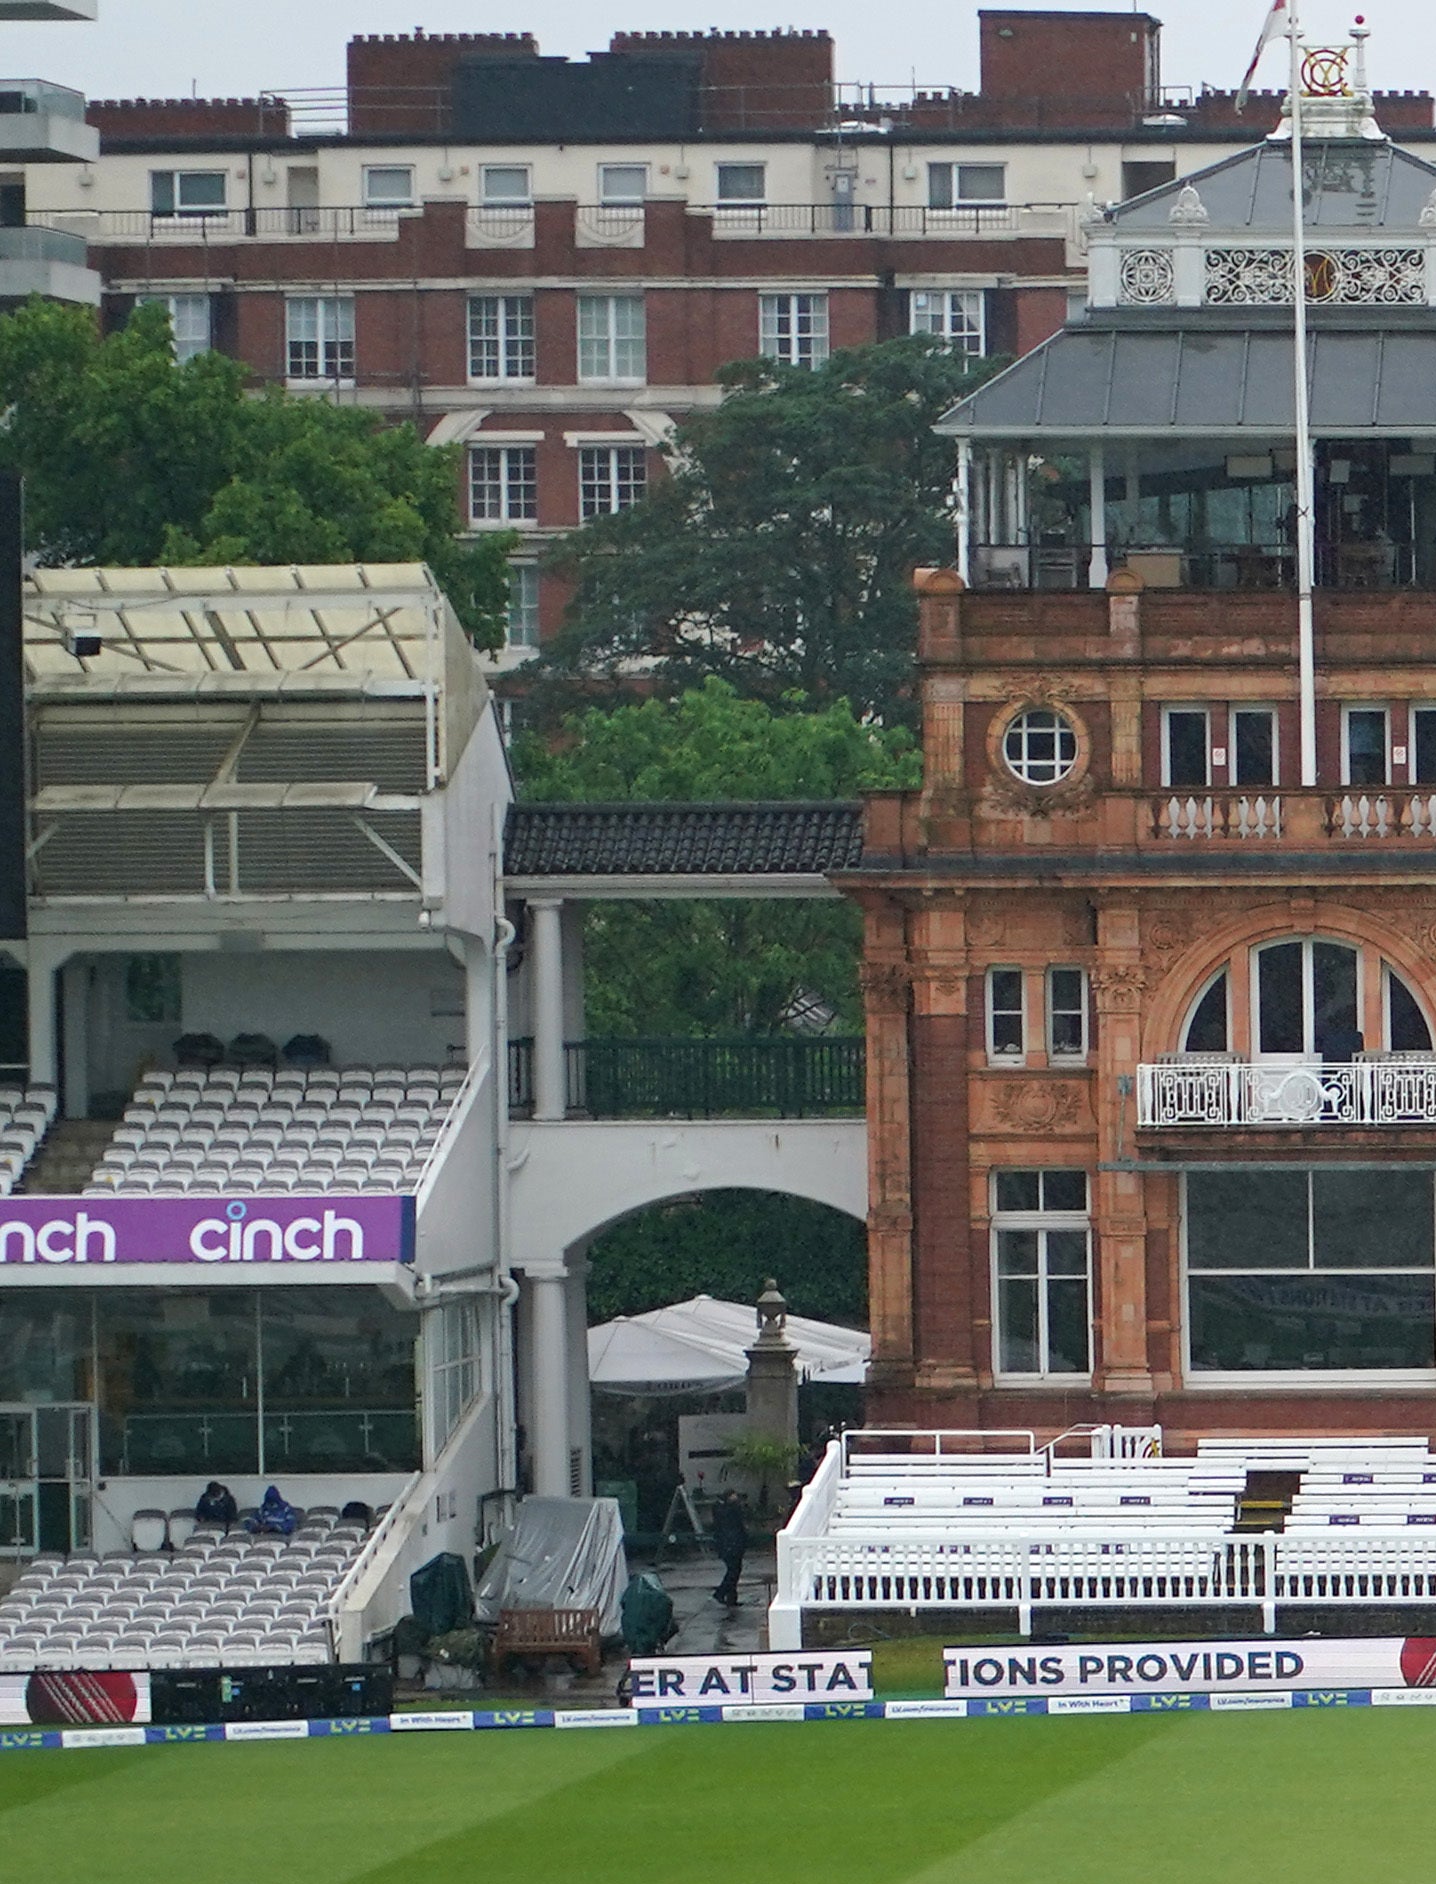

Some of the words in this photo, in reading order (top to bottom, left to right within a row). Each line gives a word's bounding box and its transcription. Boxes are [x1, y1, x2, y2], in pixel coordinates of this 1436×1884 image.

[189, 1201, 363, 1261] cinch
[700, 1666, 758, 1694] AT
[1079, 1651, 1304, 1682] PROVIDED
